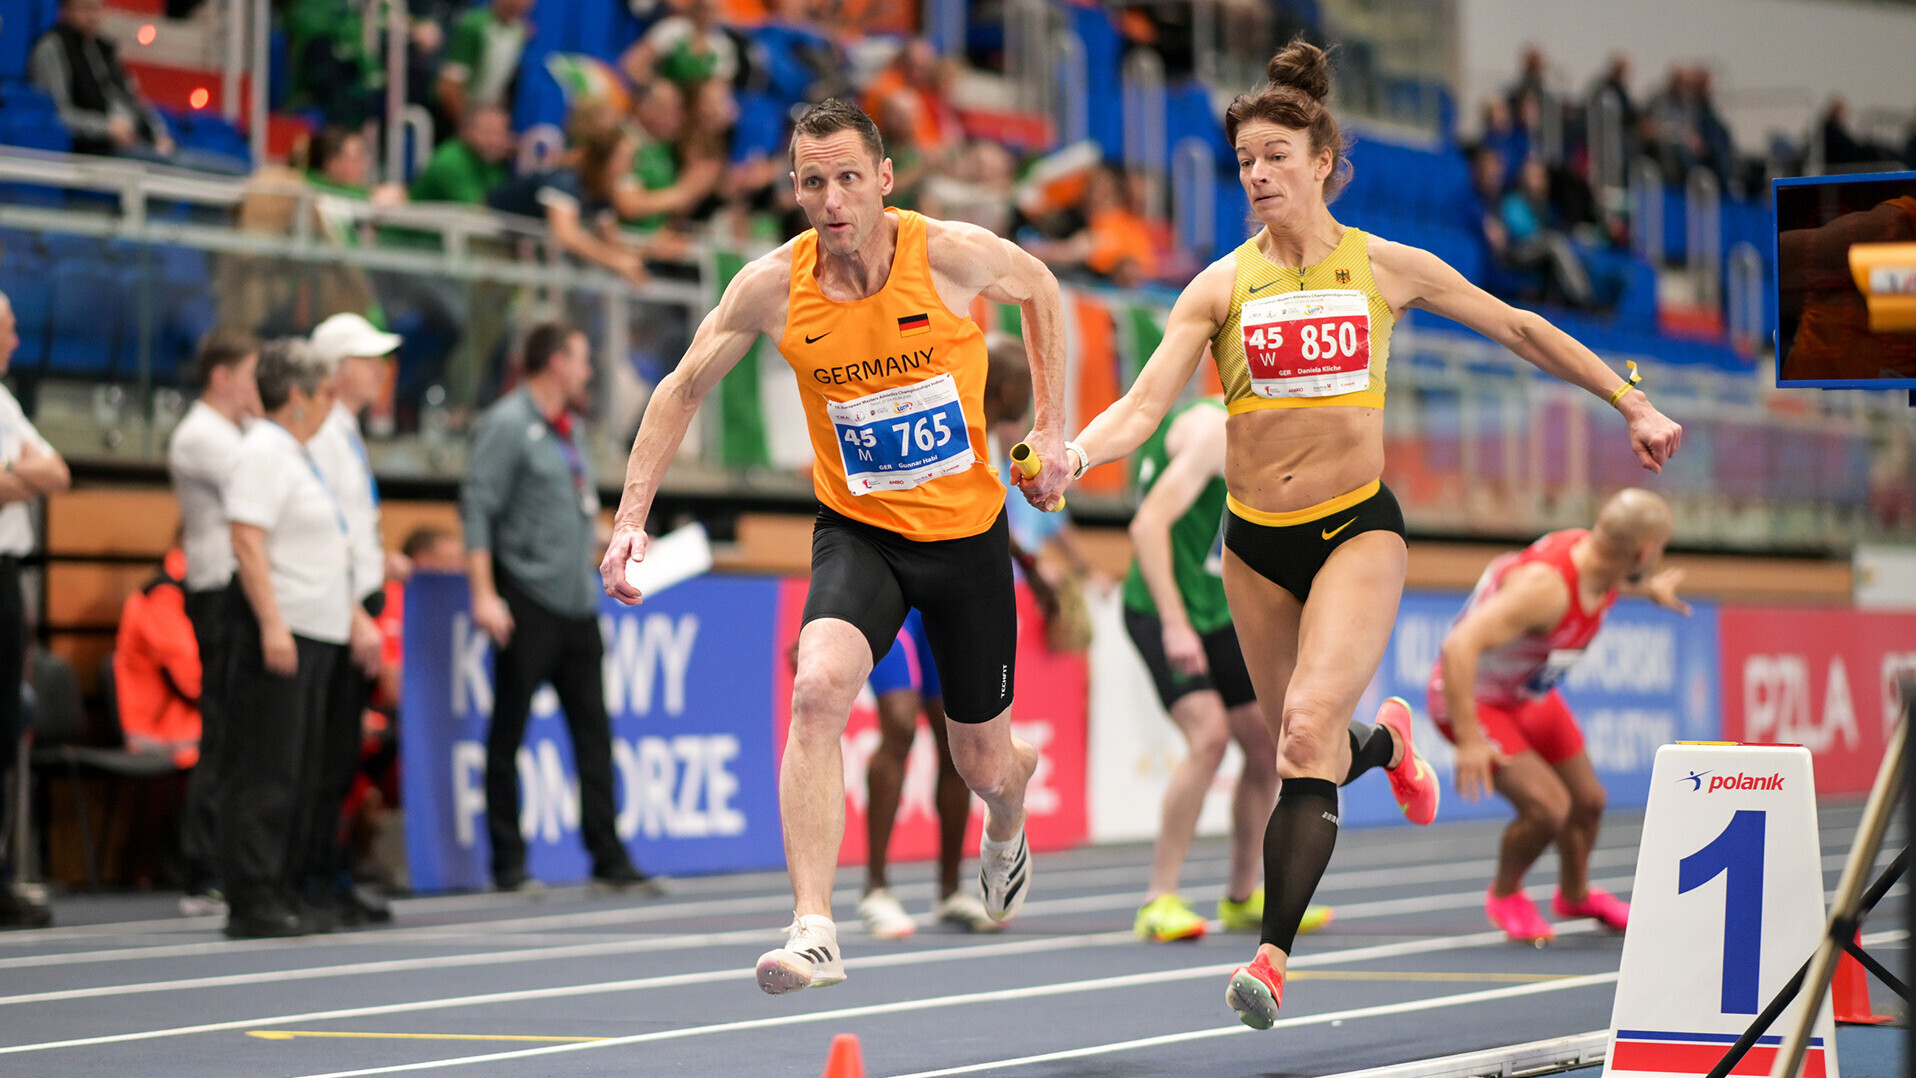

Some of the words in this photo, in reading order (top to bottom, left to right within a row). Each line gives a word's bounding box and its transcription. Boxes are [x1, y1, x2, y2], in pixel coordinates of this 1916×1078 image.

[1249, 326, 1284, 350] 45
[1300, 321, 1357, 361] 850
[813, 347, 934, 385] GERMANY
[1259, 352, 1276, 367] W
[1297, 366, 1322, 375] Daniela
[1322, 364, 1342, 373] Kliche
[897, 384, 931, 395] Championships
[844, 427, 877, 448] 45
[892, 411, 951, 457] 765
[858, 448, 873, 462] M
[878, 463, 893, 471] GER
[898, 459, 922, 469] Gunnar
[922, 454, 938, 464] Habl
[1744, 653, 1860, 755] PZLA
[1708, 772, 1785, 794] polanik
[1678, 809, 1766, 1015] 1
